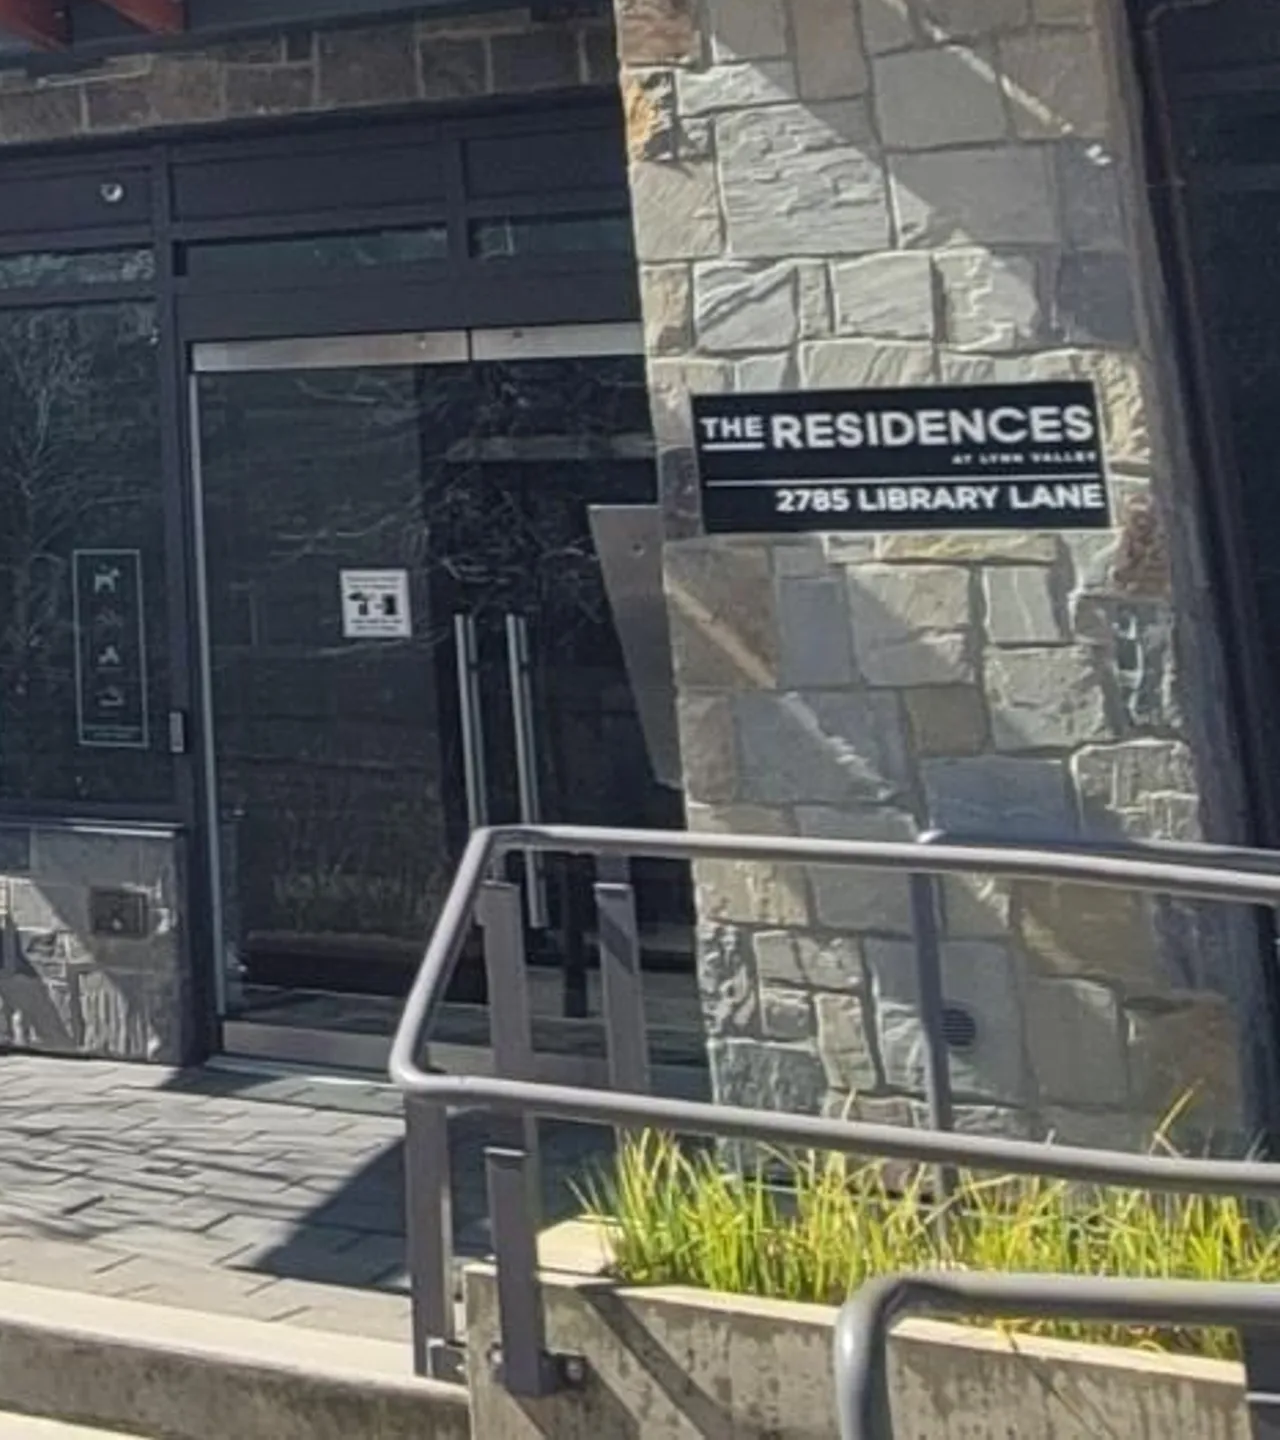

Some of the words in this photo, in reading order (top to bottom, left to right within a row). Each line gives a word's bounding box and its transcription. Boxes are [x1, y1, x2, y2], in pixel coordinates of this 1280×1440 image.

[700, 415, 765, 441] THE
[770, 404, 1094, 450] RESIDENCES
[775, 486, 852, 513] 2785
[857, 484, 1000, 512] LIBRARY
[1008, 481, 1106, 510] LANE
